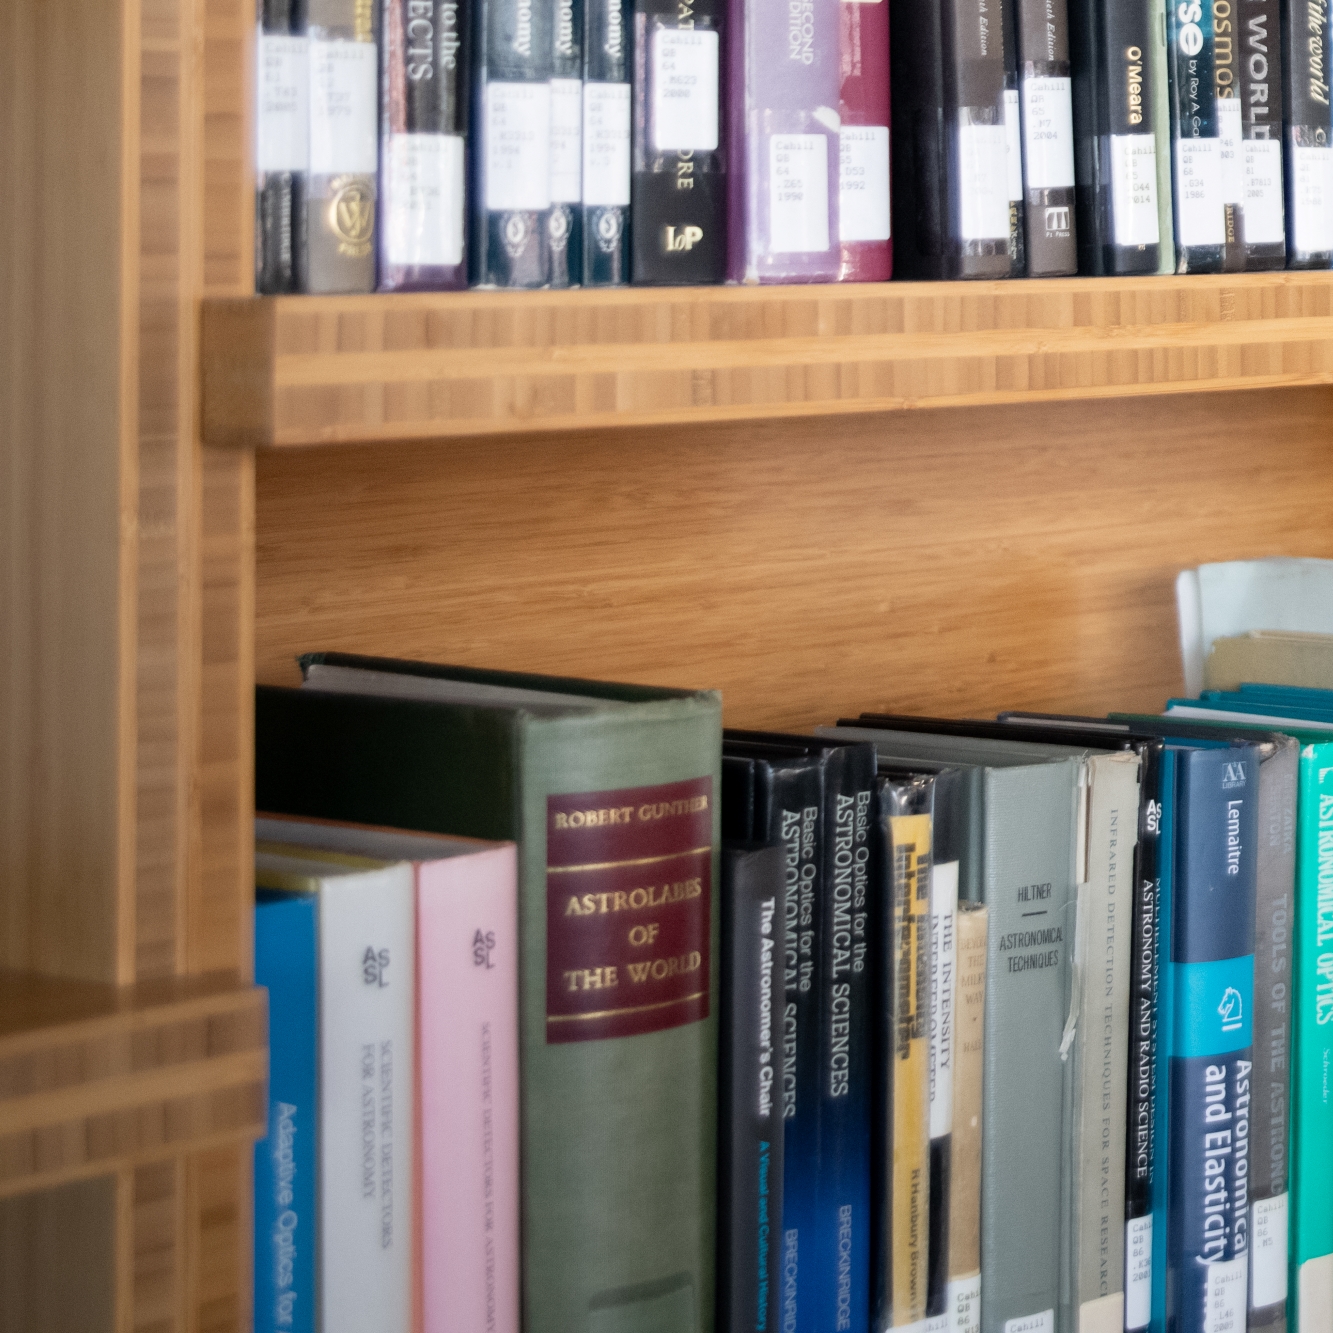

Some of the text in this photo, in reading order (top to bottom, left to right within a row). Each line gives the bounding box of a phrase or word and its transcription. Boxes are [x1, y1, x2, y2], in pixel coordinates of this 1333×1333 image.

[441, 2, 459, 27] to
[1308, 4, 1326, 36] the
[441, 31, 461, 70] the
[978, 16, 991, 57] Edition
[1046, 22, 1057, 61] Edition
[1127, 46, 1143, 125] O'Meara
[1309, 37, 1328, 106] world
[554, 805, 635, 831] ROBERT
[564, 876, 703, 917] ASTROLABES
[798, 806, 818, 992] Basic Optics for the
[1017, 882, 1053, 902] HILTNER
[627, 922, 661, 947] OF
[830, 793, 855, 1098] ASTRONOMICAL SCIENCES
[998, 927, 1064, 951] ASTRONOMICAL
[563, 950, 702, 992] THE WORLD
[1007, 949, 1060, 974] TECHNIQUES
[759, 895, 776, 1117] The Astronomer's Chair
[1099, 808, 1119, 1210] INFRARED DETECTION TECHNIQUES FOR SPACE
[1137, 878, 1154, 1179] ASTRONOMY AND RADIO SCIENCE
[1196, 1064, 1233, 1268] and Elasticity
